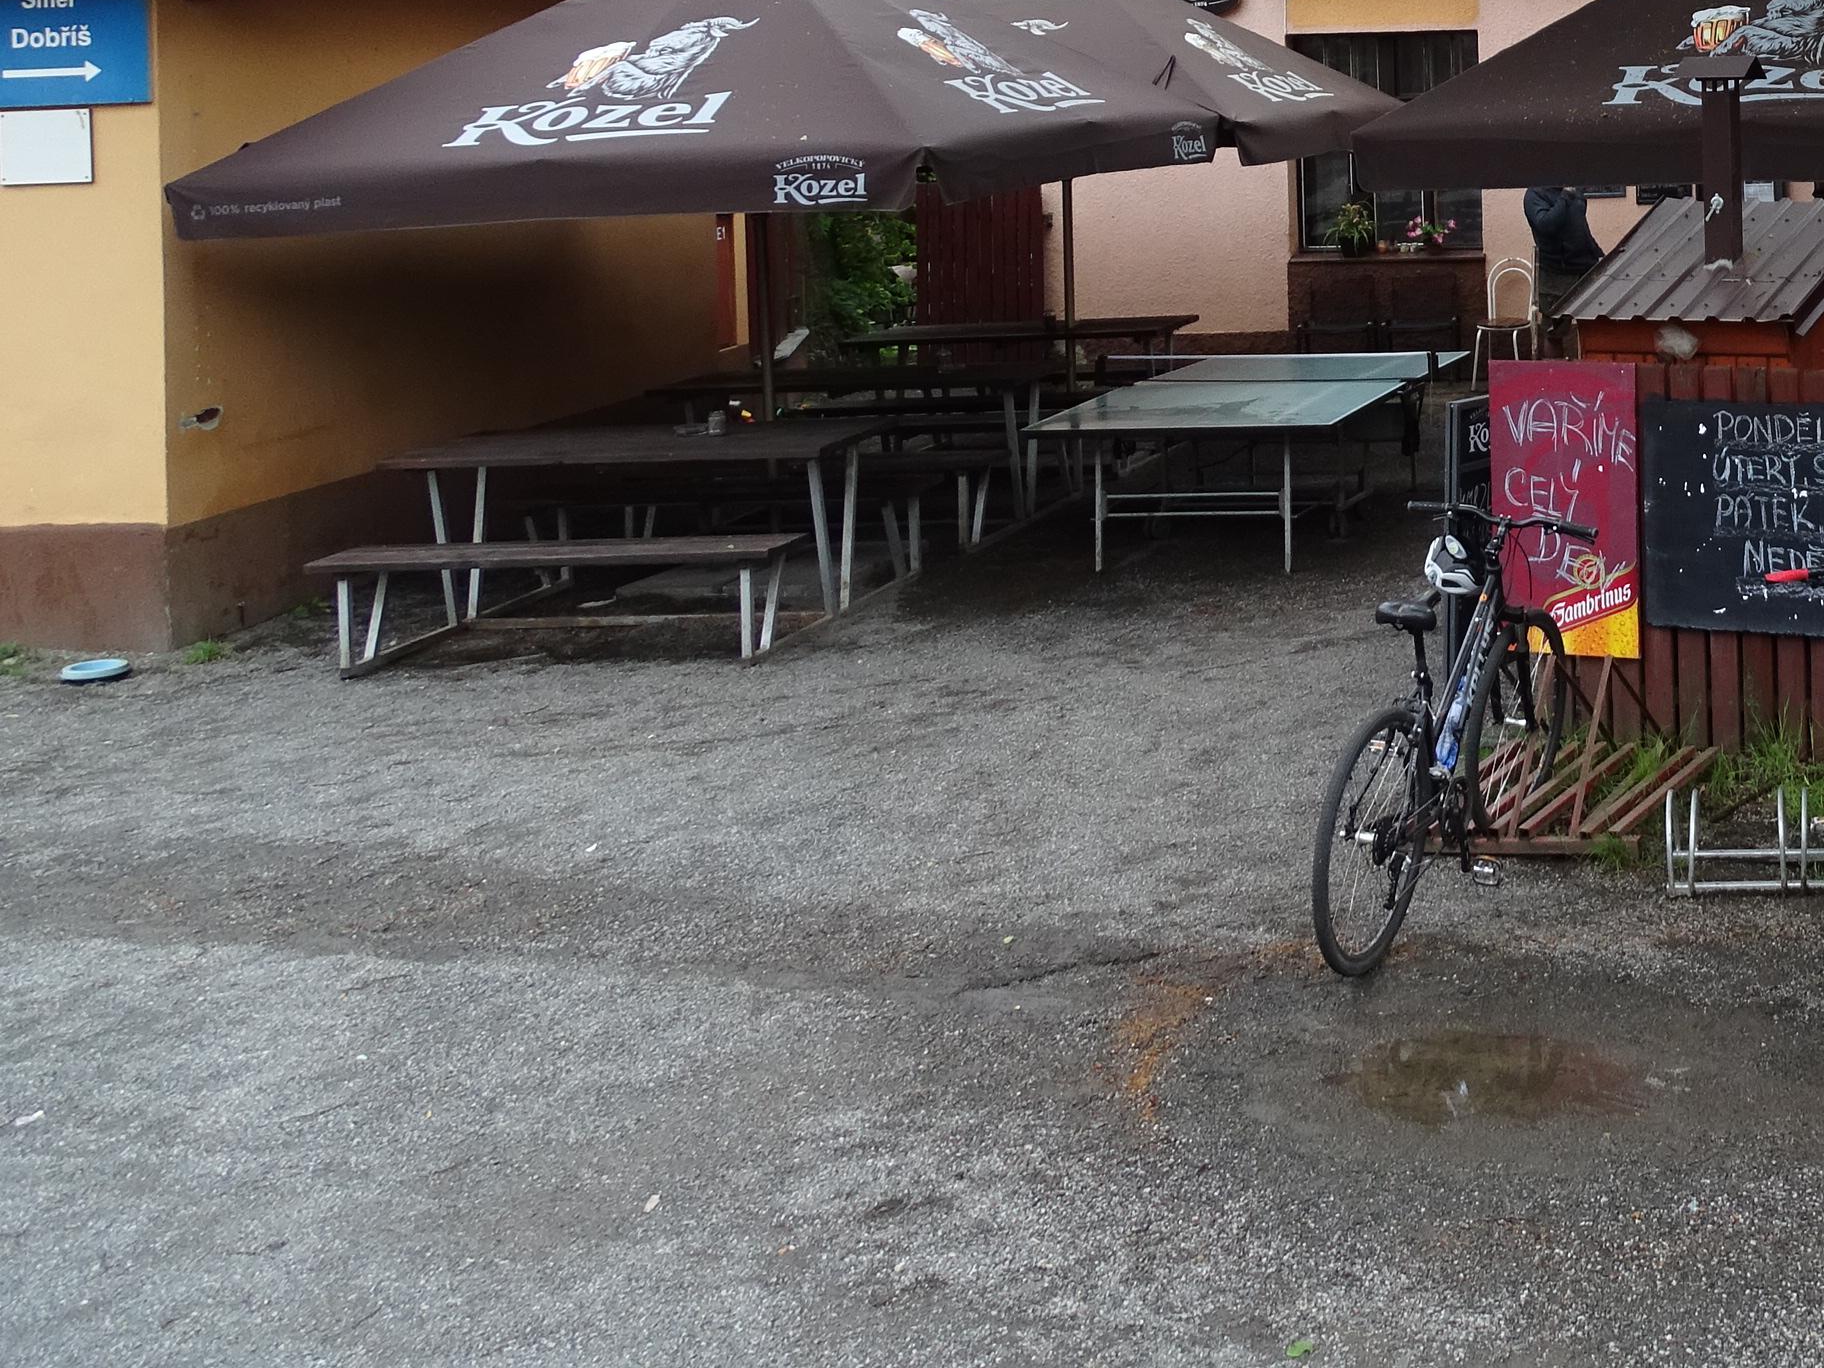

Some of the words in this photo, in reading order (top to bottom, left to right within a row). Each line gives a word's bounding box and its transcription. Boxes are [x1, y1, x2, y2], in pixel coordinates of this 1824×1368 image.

[11, 23, 93, 50] Dobříš
[943, 71, 1094, 114] Kozel
[1226, 70, 1325, 102] Kozel
[441, 90, 735, 148] Kozel
[1171, 134, 1207, 160] Kozel
[773, 172, 868, 206] Kozel
[1502, 390, 1637, 472] VAŘÍME
[1504, 458, 1582, 523] CELÝ
[1549, 583, 1632, 627] Gambrinus
